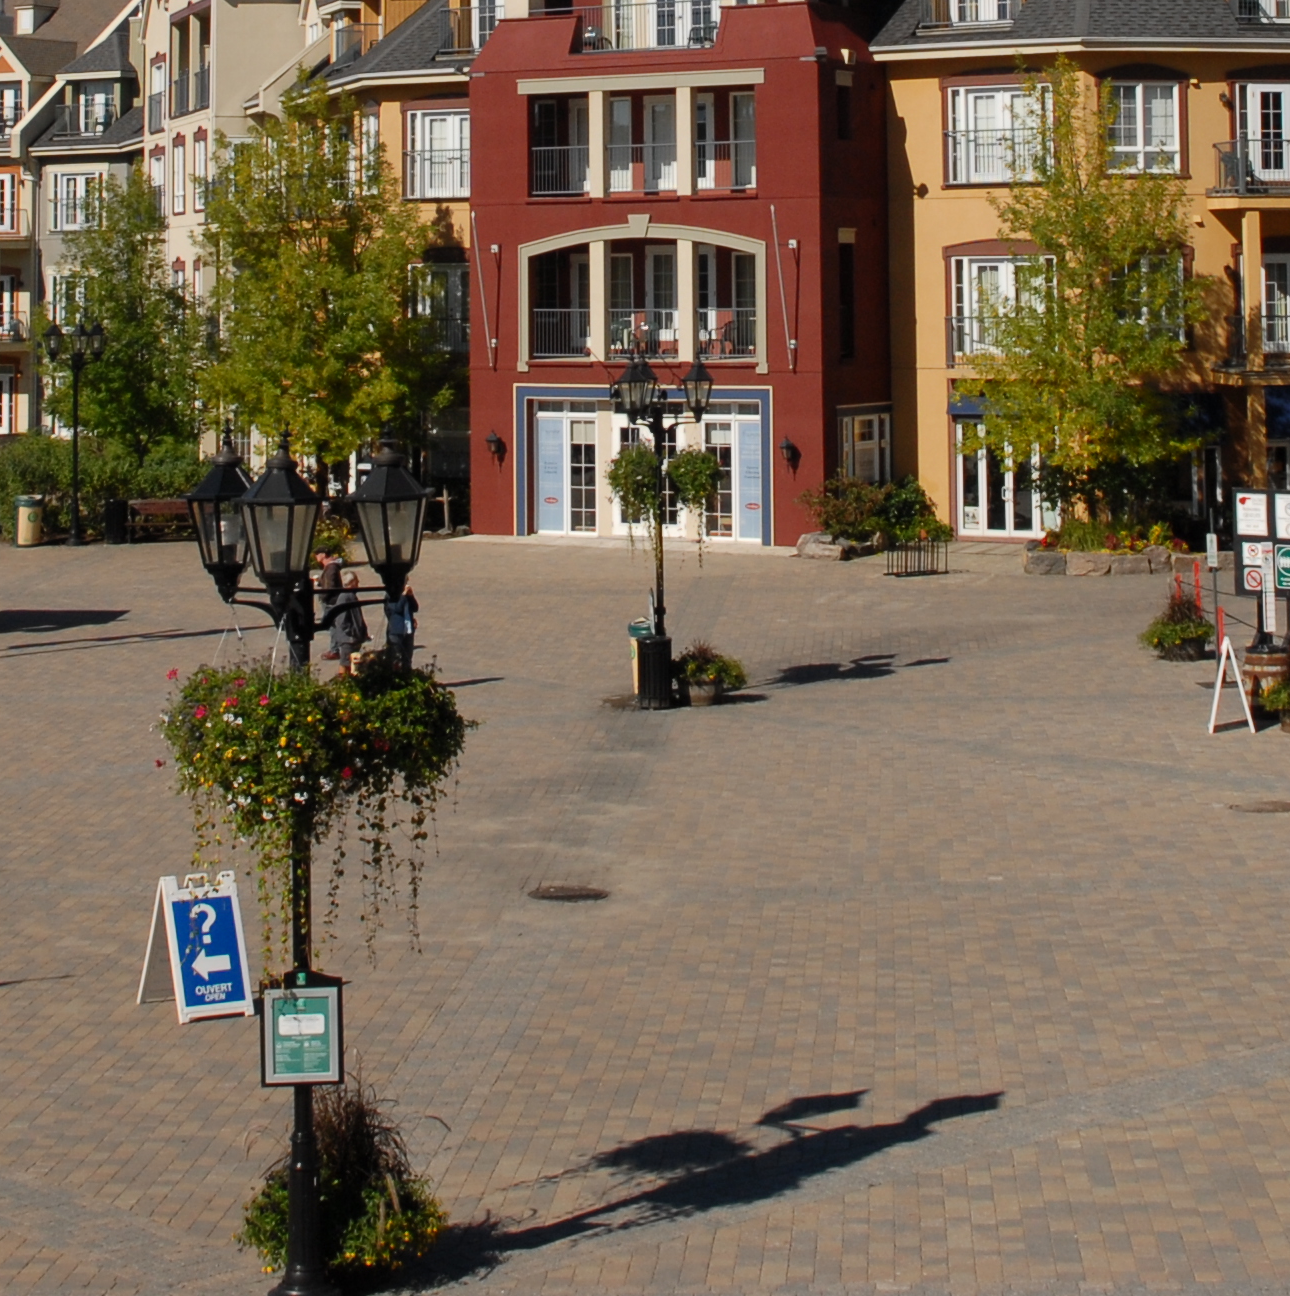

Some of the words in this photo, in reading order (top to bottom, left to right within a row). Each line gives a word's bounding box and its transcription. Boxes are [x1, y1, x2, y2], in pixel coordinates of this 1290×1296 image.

[190, 903, 217, 944] ?
[195, 982, 233, 995] OUVERT
[204, 992, 226, 1002] OPEN
